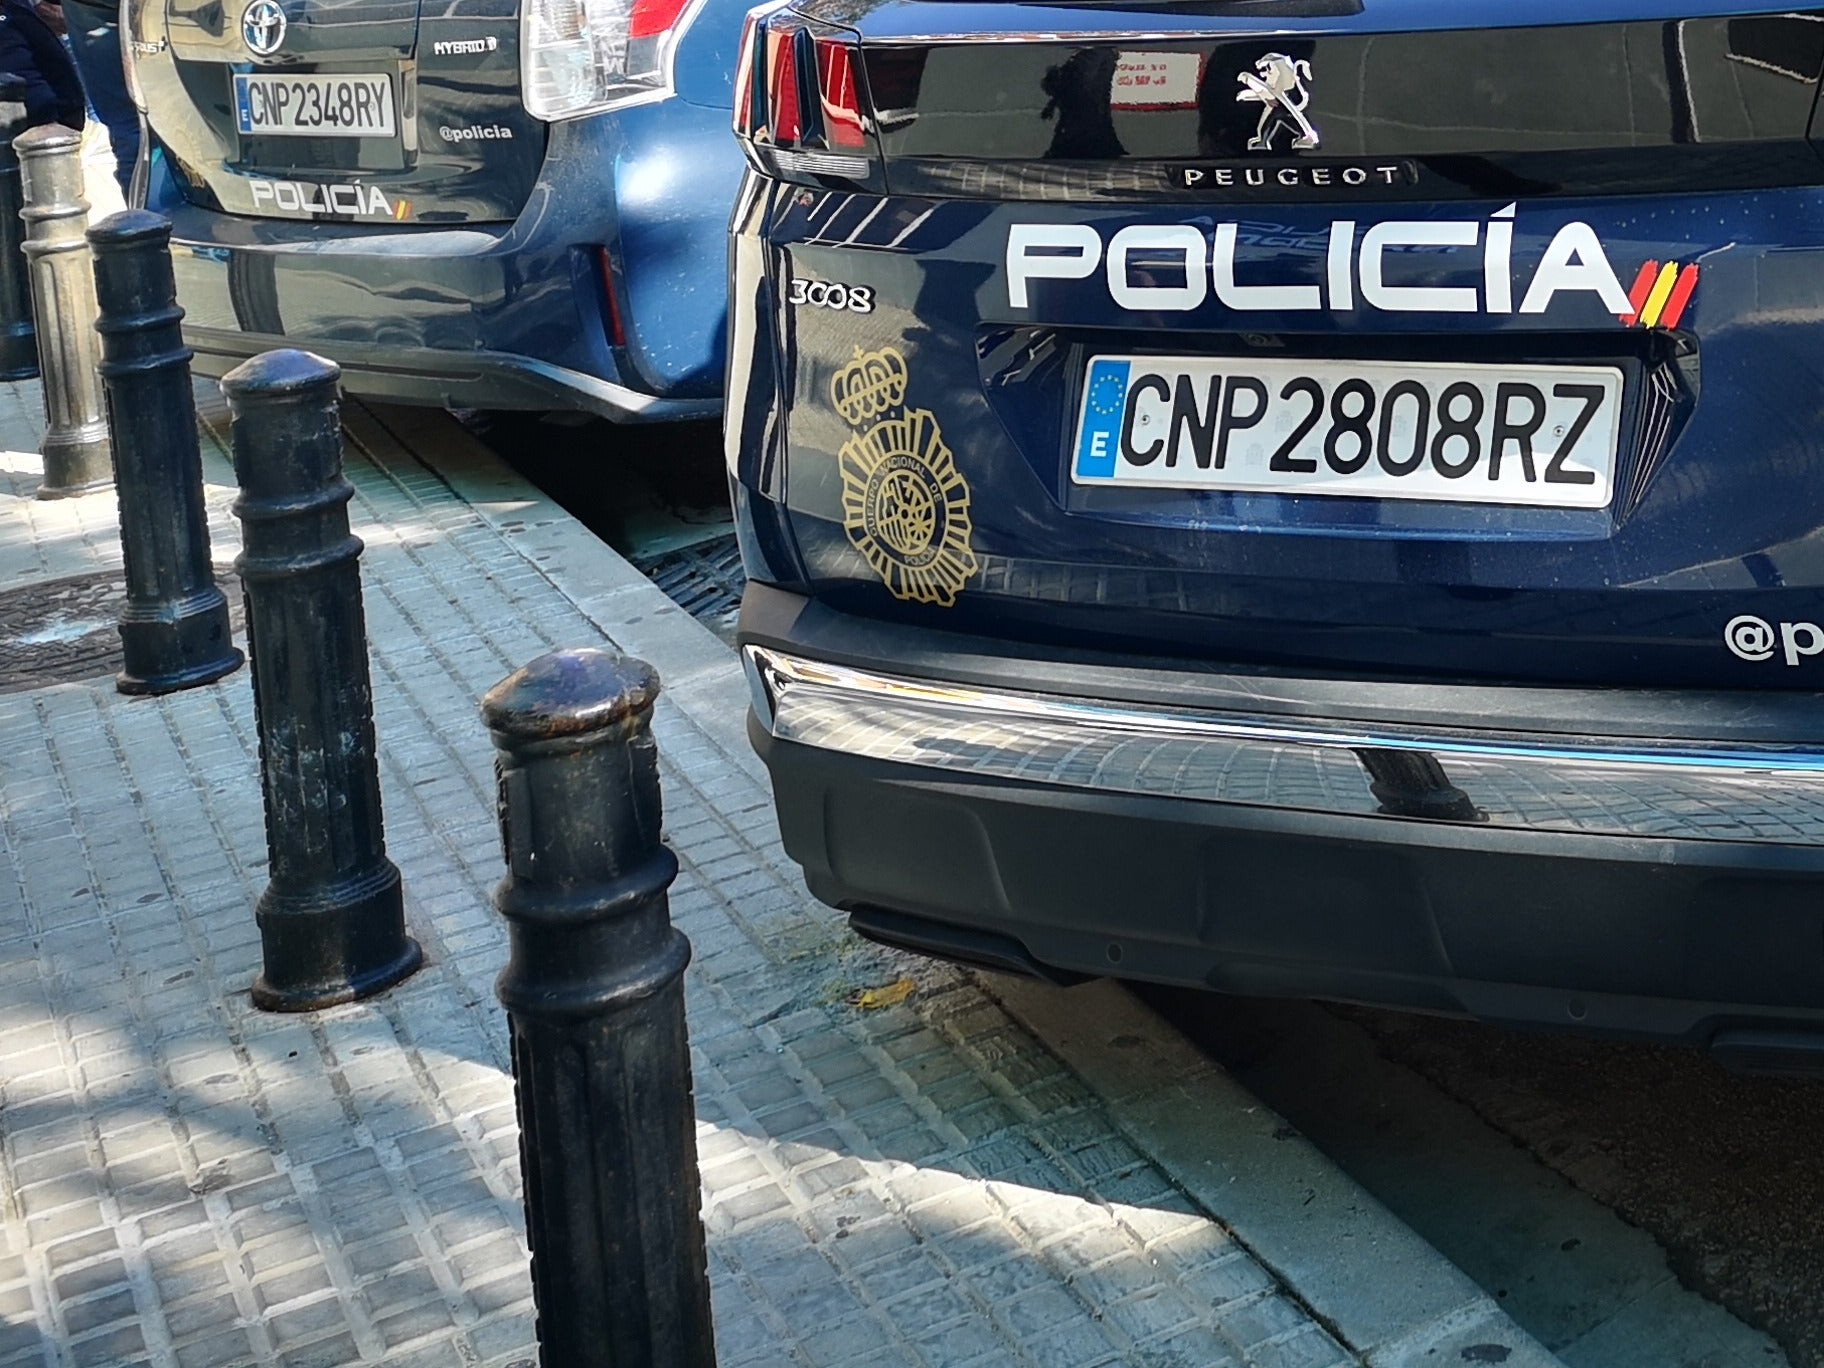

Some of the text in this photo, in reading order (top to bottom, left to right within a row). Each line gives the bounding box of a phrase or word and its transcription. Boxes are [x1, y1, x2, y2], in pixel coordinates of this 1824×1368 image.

[250, 81, 386, 128] CNP2348RY
[439, 124, 513, 143] @policia
[1184, 165, 1399, 188] PEUGEOT
[250, 179, 393, 216] POLICÍA
[1005, 201, 1635, 315] POLICÍA
[789, 279, 875, 314] 3008
[1089, 431, 1108, 458] E
[1120, 373, 1607, 486] CNP2808RZ
[929, 482, 943, 503] DE
